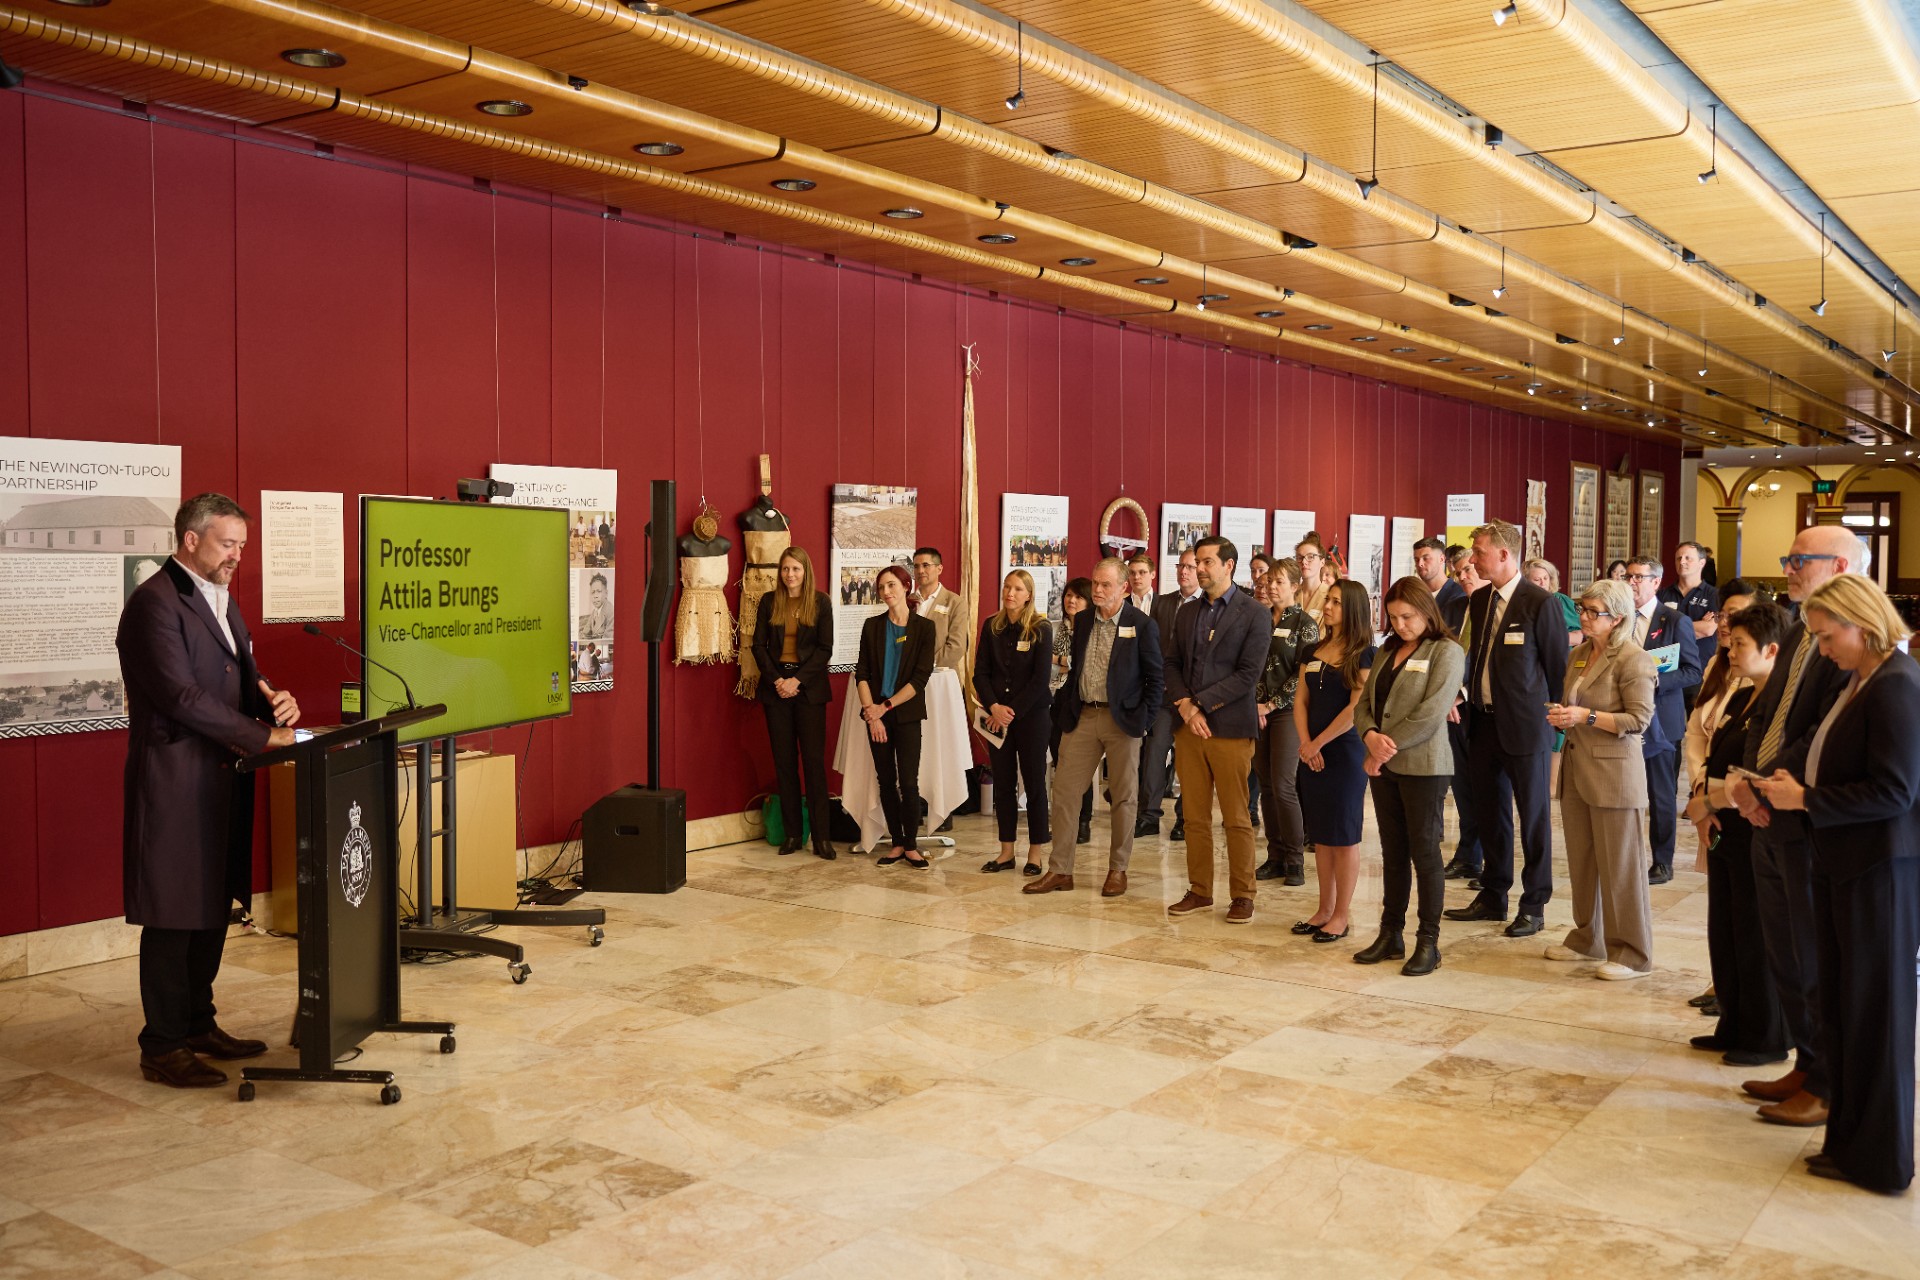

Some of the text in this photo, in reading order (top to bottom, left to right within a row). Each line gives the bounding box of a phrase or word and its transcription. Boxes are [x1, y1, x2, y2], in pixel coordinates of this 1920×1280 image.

[0, 459, 170, 478] THE NEWINGTON-TUPOU
[0, 477, 98, 491] PARTNERSHIP
[552, 498, 598, 508] EXCHANGE
[380, 538, 471, 567] Professor
[379, 580, 499, 613] Attila Brungs
[379, 616, 542, 643] Vice-Chancellor and President
